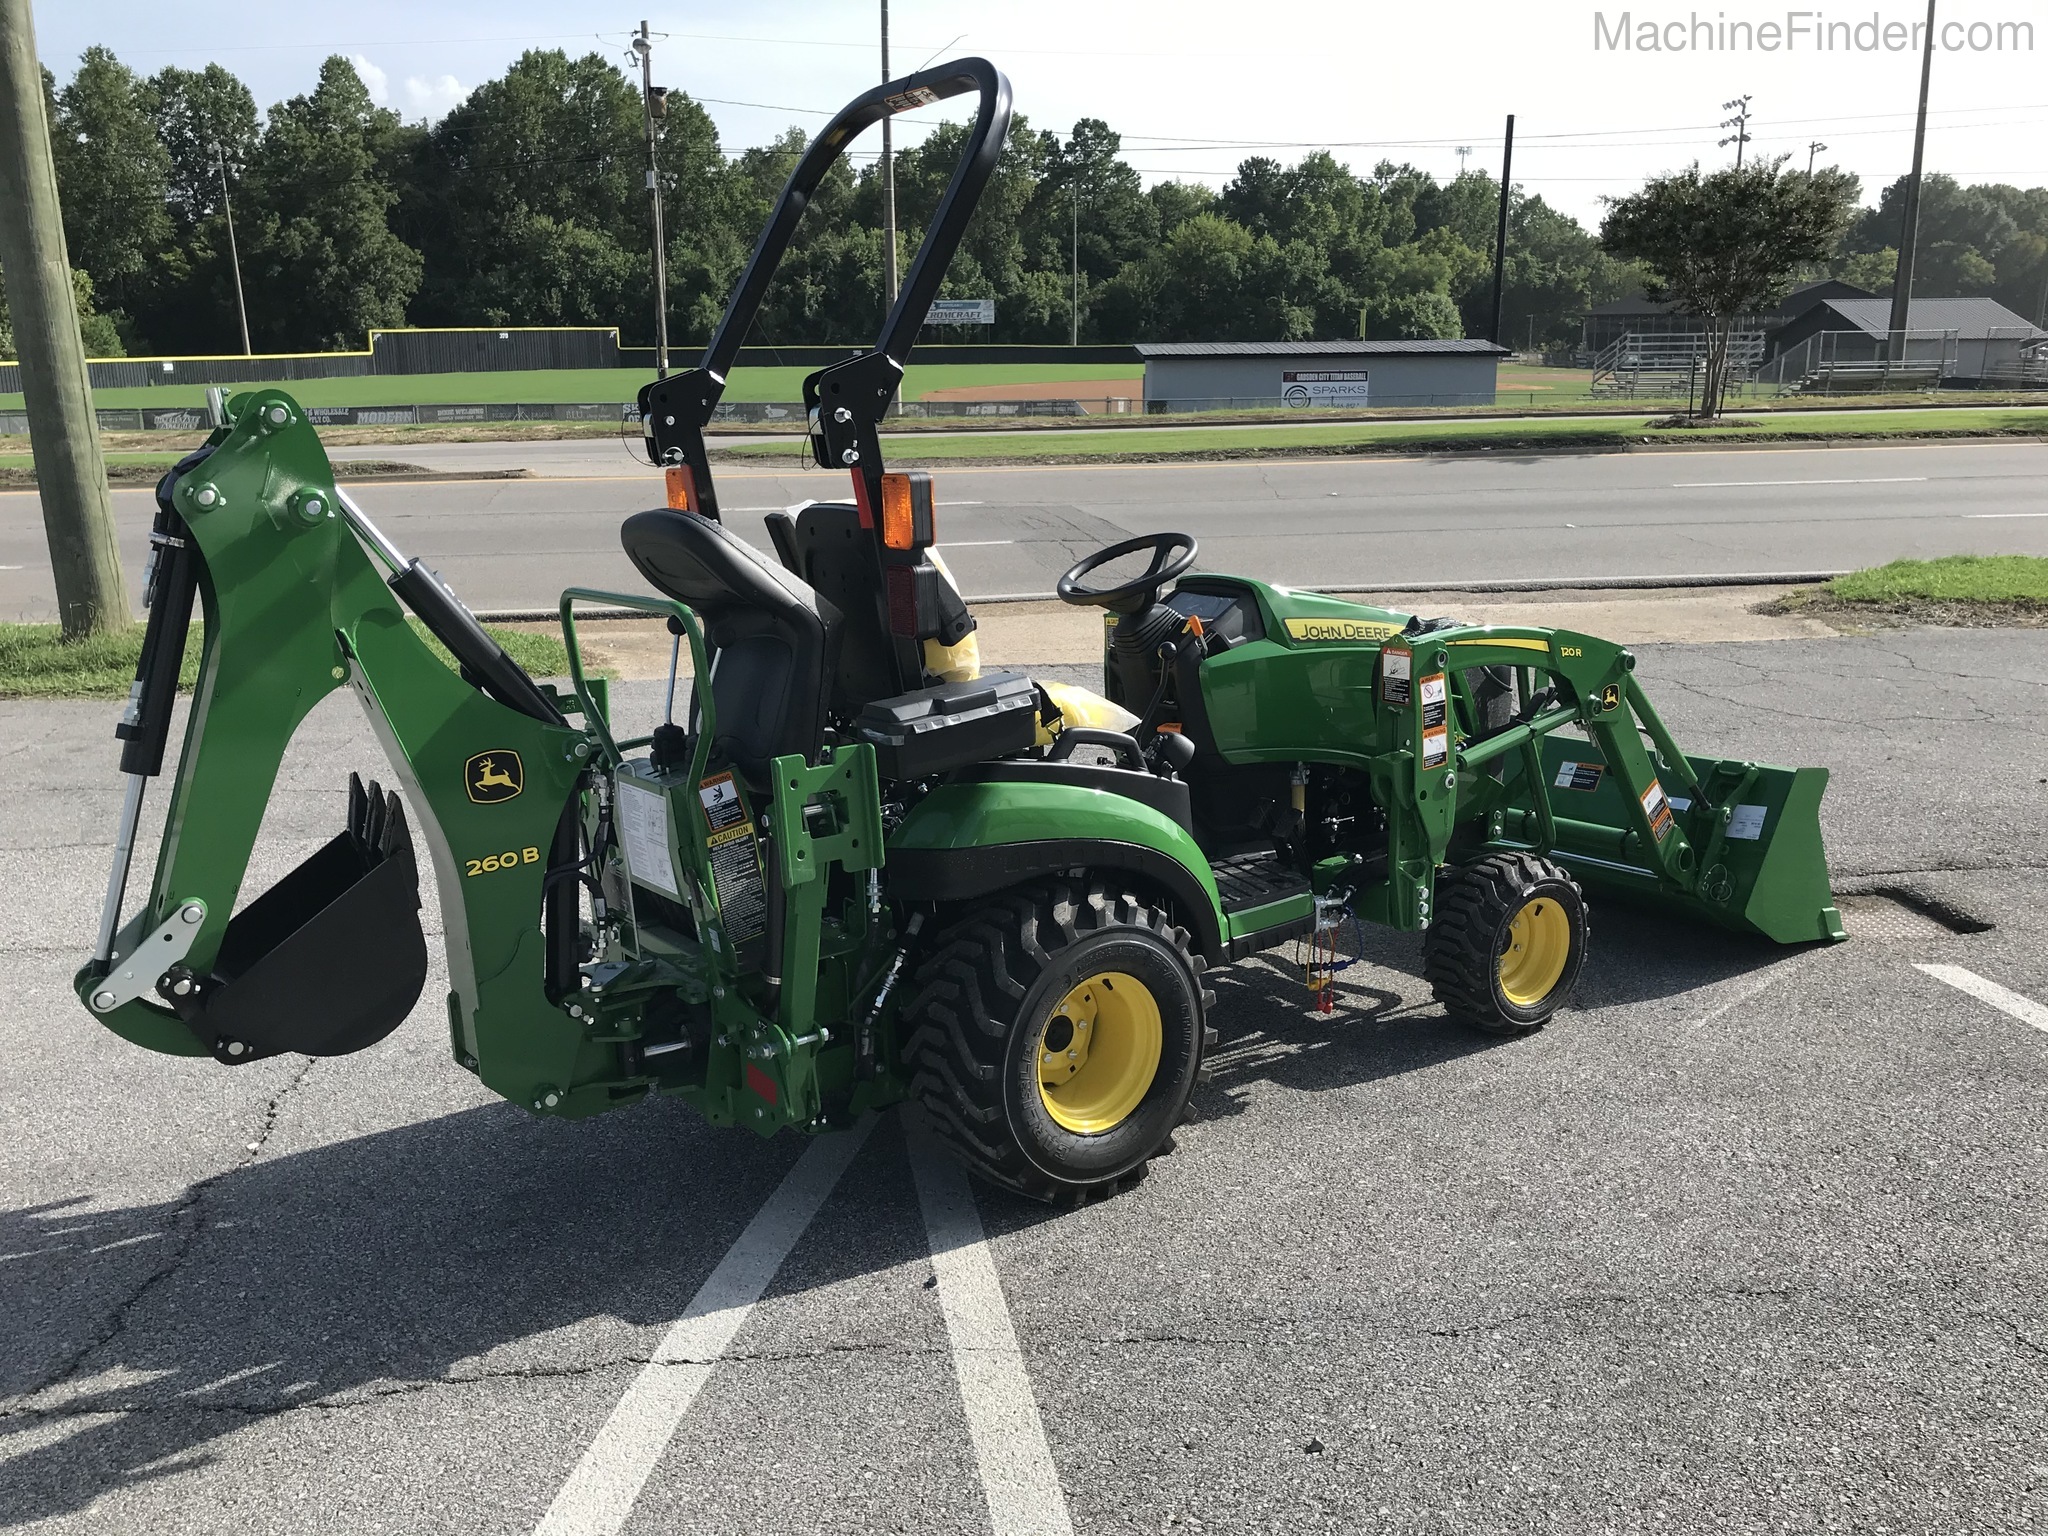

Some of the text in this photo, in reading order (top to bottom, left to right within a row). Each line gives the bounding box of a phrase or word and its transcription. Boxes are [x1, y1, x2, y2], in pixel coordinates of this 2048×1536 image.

[1319, 373, 1330, 381] CITY
[1344, 373, 1366, 381] BASEBALL
[1312, 386, 1366, 395] SPARKS
[314, 408, 350, 416] WHOLESALE
[357, 411, 414, 424] MODERN
[1300, 624, 1391, 640] JOHN DEERE
[1560, 646, 1582, 658] 120 R
[717, 825, 749, 843] CAUTION
[465, 846, 540, 877] 260 B
